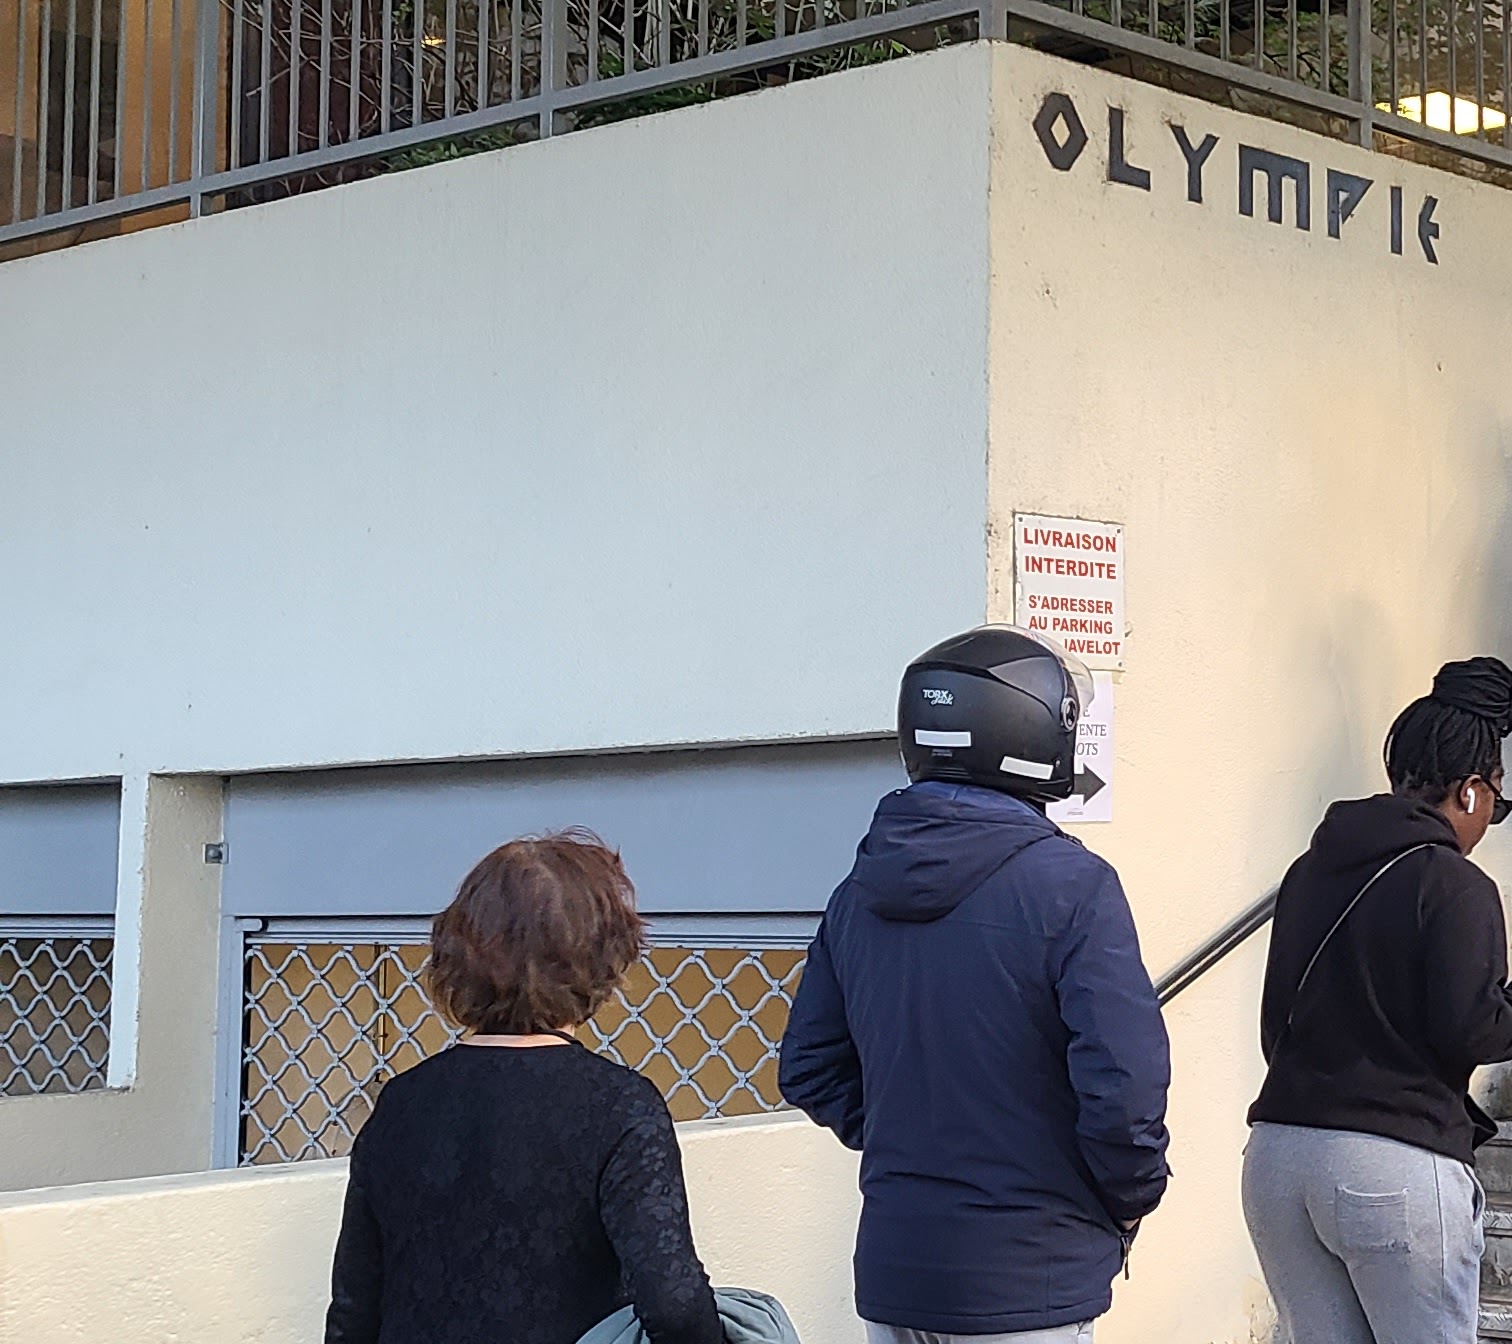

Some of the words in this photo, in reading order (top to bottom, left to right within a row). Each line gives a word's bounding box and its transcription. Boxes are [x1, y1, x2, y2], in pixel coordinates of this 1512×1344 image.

[1023, 527, 1117, 553] LIVRAISON
[1025, 555, 1117, 580] INTERDITE
[1028, 594, 1114, 615] S'ADRESSER
[1028, 616, 1048, 630] AU
[1052, 617, 1113, 635] PARKING
[1077, 723, 1107, 736] ENTE
